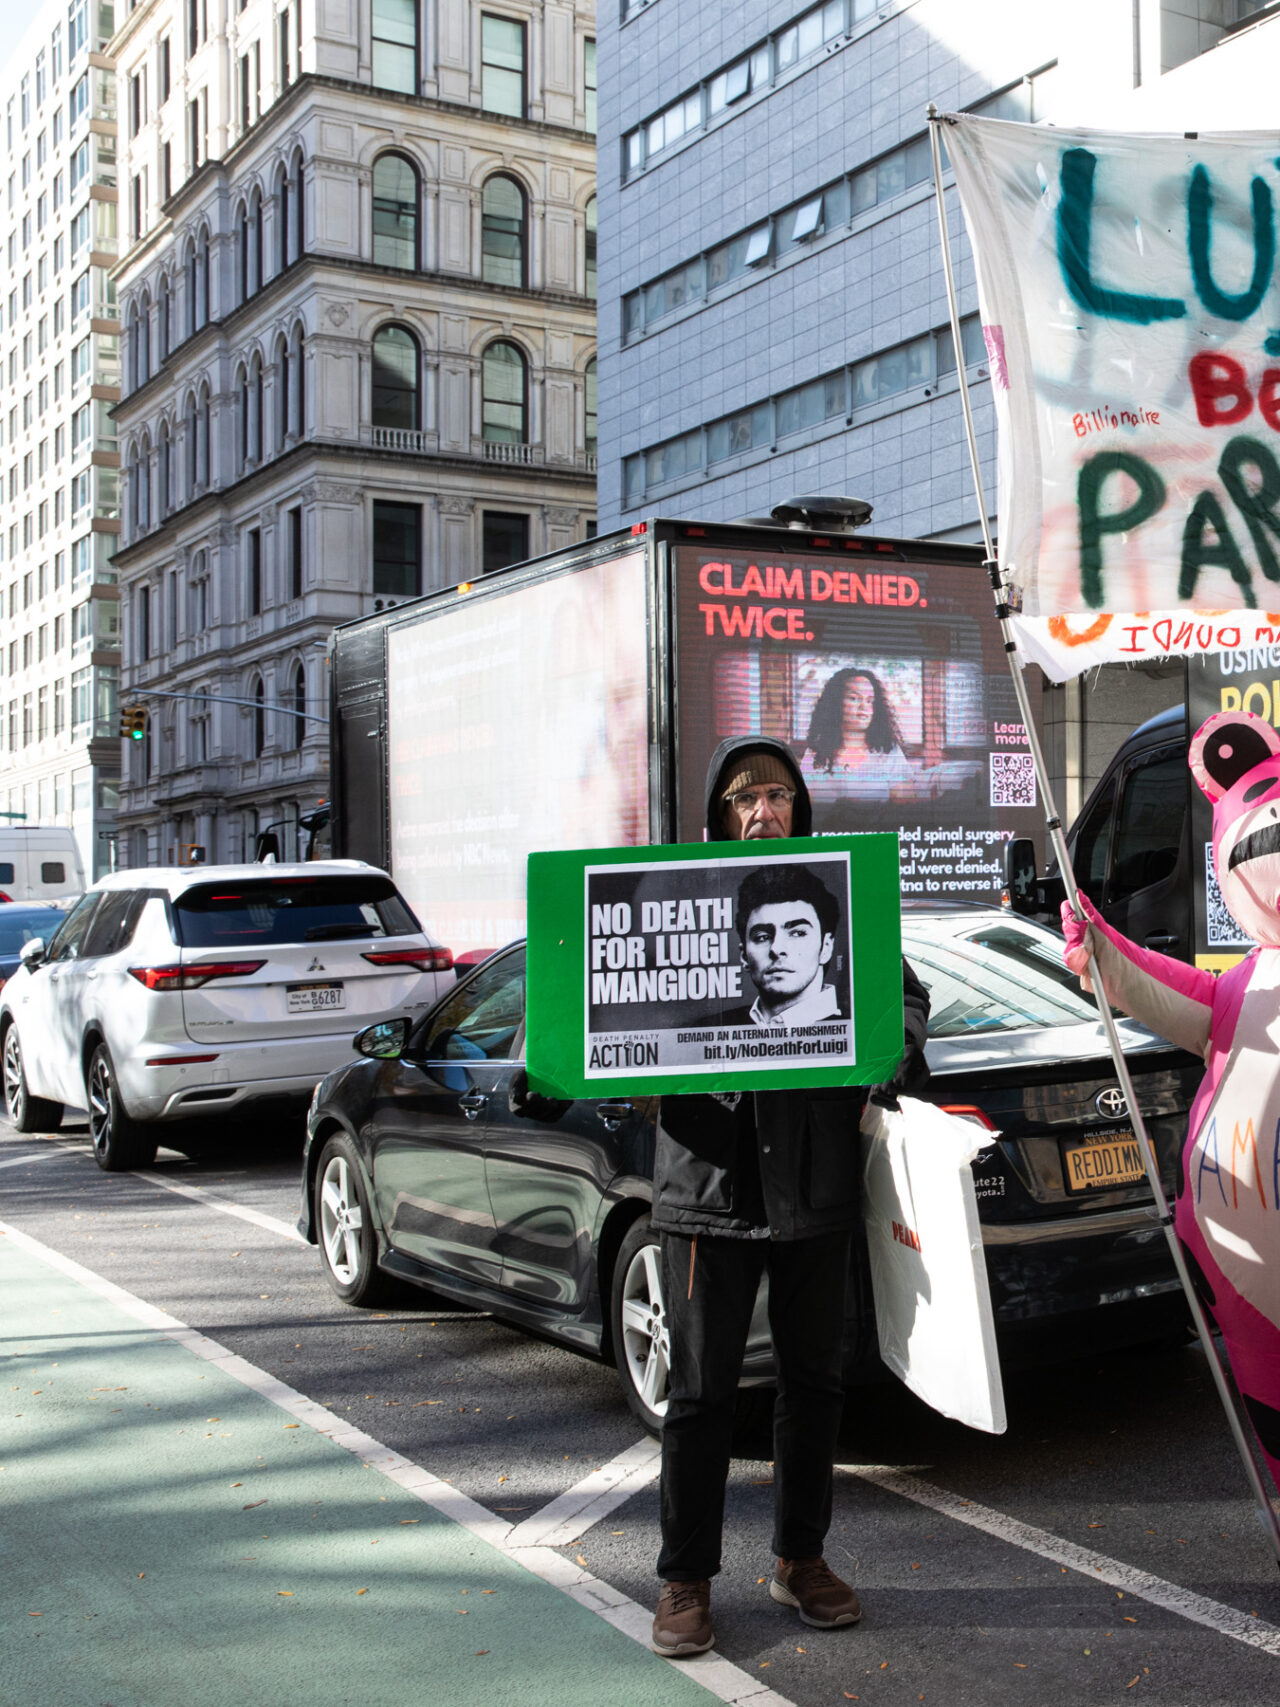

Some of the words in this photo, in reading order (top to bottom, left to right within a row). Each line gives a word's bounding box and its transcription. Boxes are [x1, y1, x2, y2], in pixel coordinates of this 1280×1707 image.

[1073, 405, 1160, 438] Billionaire
[699, 563, 805, 600] CLAIM
[811, 570, 928, 608] DENIED.
[699, 603, 815, 641] TWICE.
[995, 734, 1029, 745] more
[924, 827, 964, 845] spinal
[966, 828, 1015, 845] surgery
[911, 843, 928, 859] by
[931, 843, 984, 860] multiple
[919, 864, 952, 876] were
[955, 859, 1003, 875] denied.
[901, 879, 924, 893] tna
[927, 879, 940, 892] to
[942, 878, 989, 892] reverse
[592, 902, 632, 936] NO
[641, 897, 733, 934] DEATH
[592, 935, 647, 970] FOR
[655, 932, 729, 967] LUIGI
[592, 965, 743, 1005] MANGIONE
[593, 1035, 620, 1043] DEATH
[624, 1033, 660, 1042] PENALTY
[677, 1031, 715, 1043] DEMAND
[717, 1030, 730, 1042] AN
[732, 1027, 788, 1041] ALTERNATIVE
[790, 1024, 847, 1038] PUNISHMENT
[703, 1038, 848, 1061] bit.ly/NoDeathForLuigi
[1072, 1143, 1145, 1181] REDDIMN
[974, 1176, 1005, 1188] ute22
